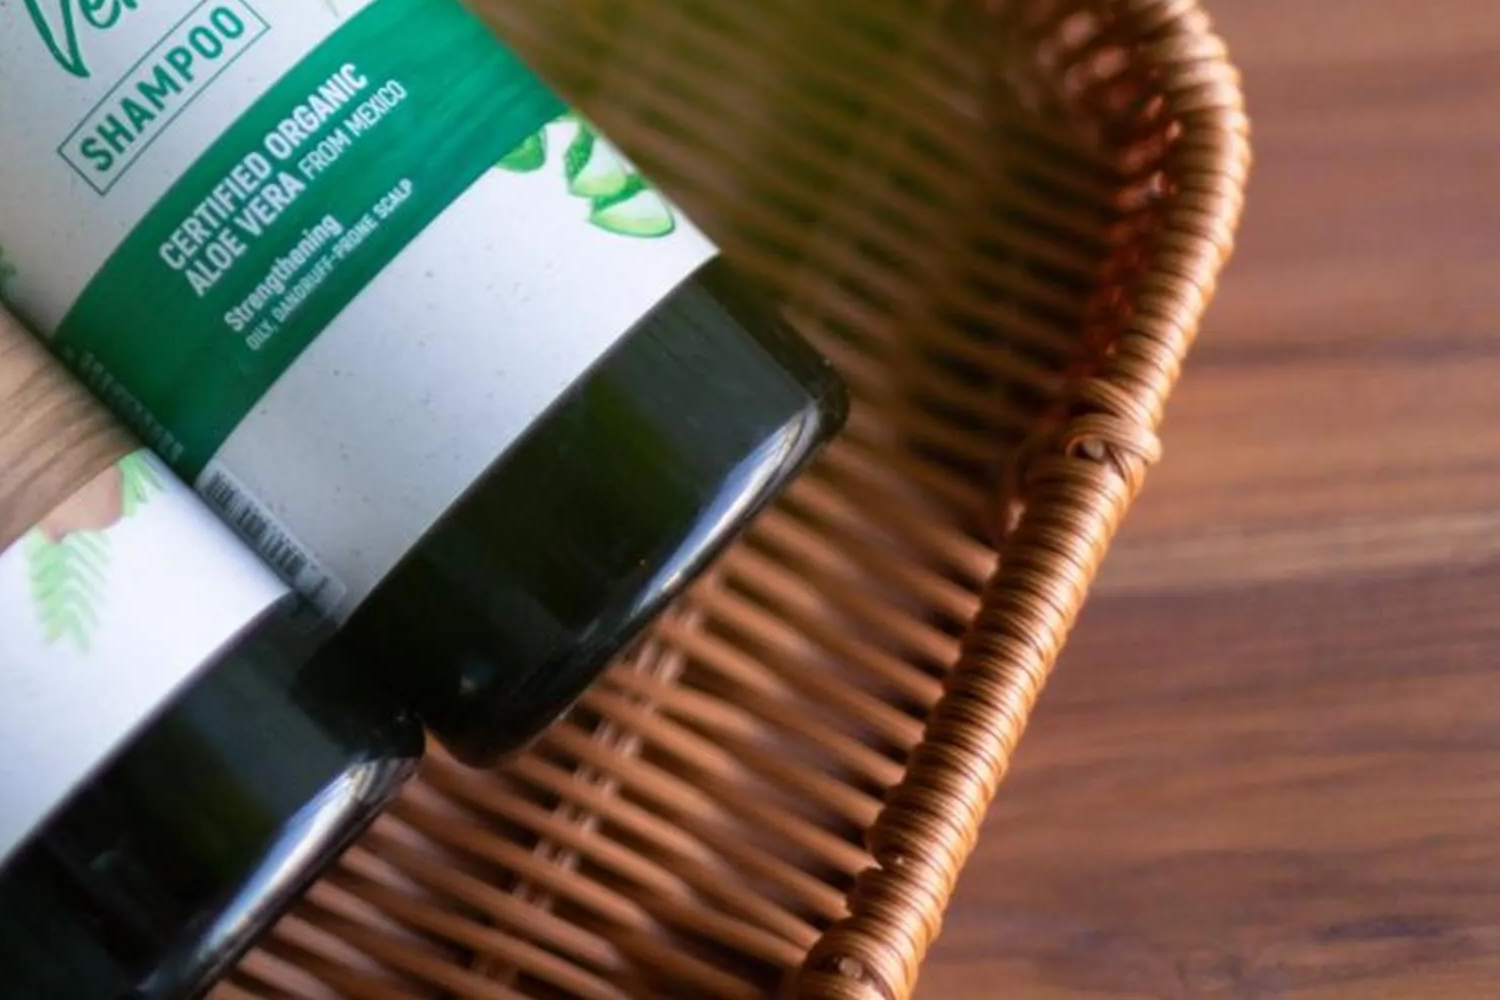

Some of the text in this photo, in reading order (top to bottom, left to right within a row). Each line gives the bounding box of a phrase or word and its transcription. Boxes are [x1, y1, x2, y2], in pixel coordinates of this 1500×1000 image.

[80, 6, 244, 171] SHAMPOO
[159, 63, 368, 269] CERTIFIED ORGANIC
[185, 79, 407, 297] ALOE VERA FROM MEXICO
[373, 178, 413, 219] SCALP
[224, 214, 343, 332] Strengthening
